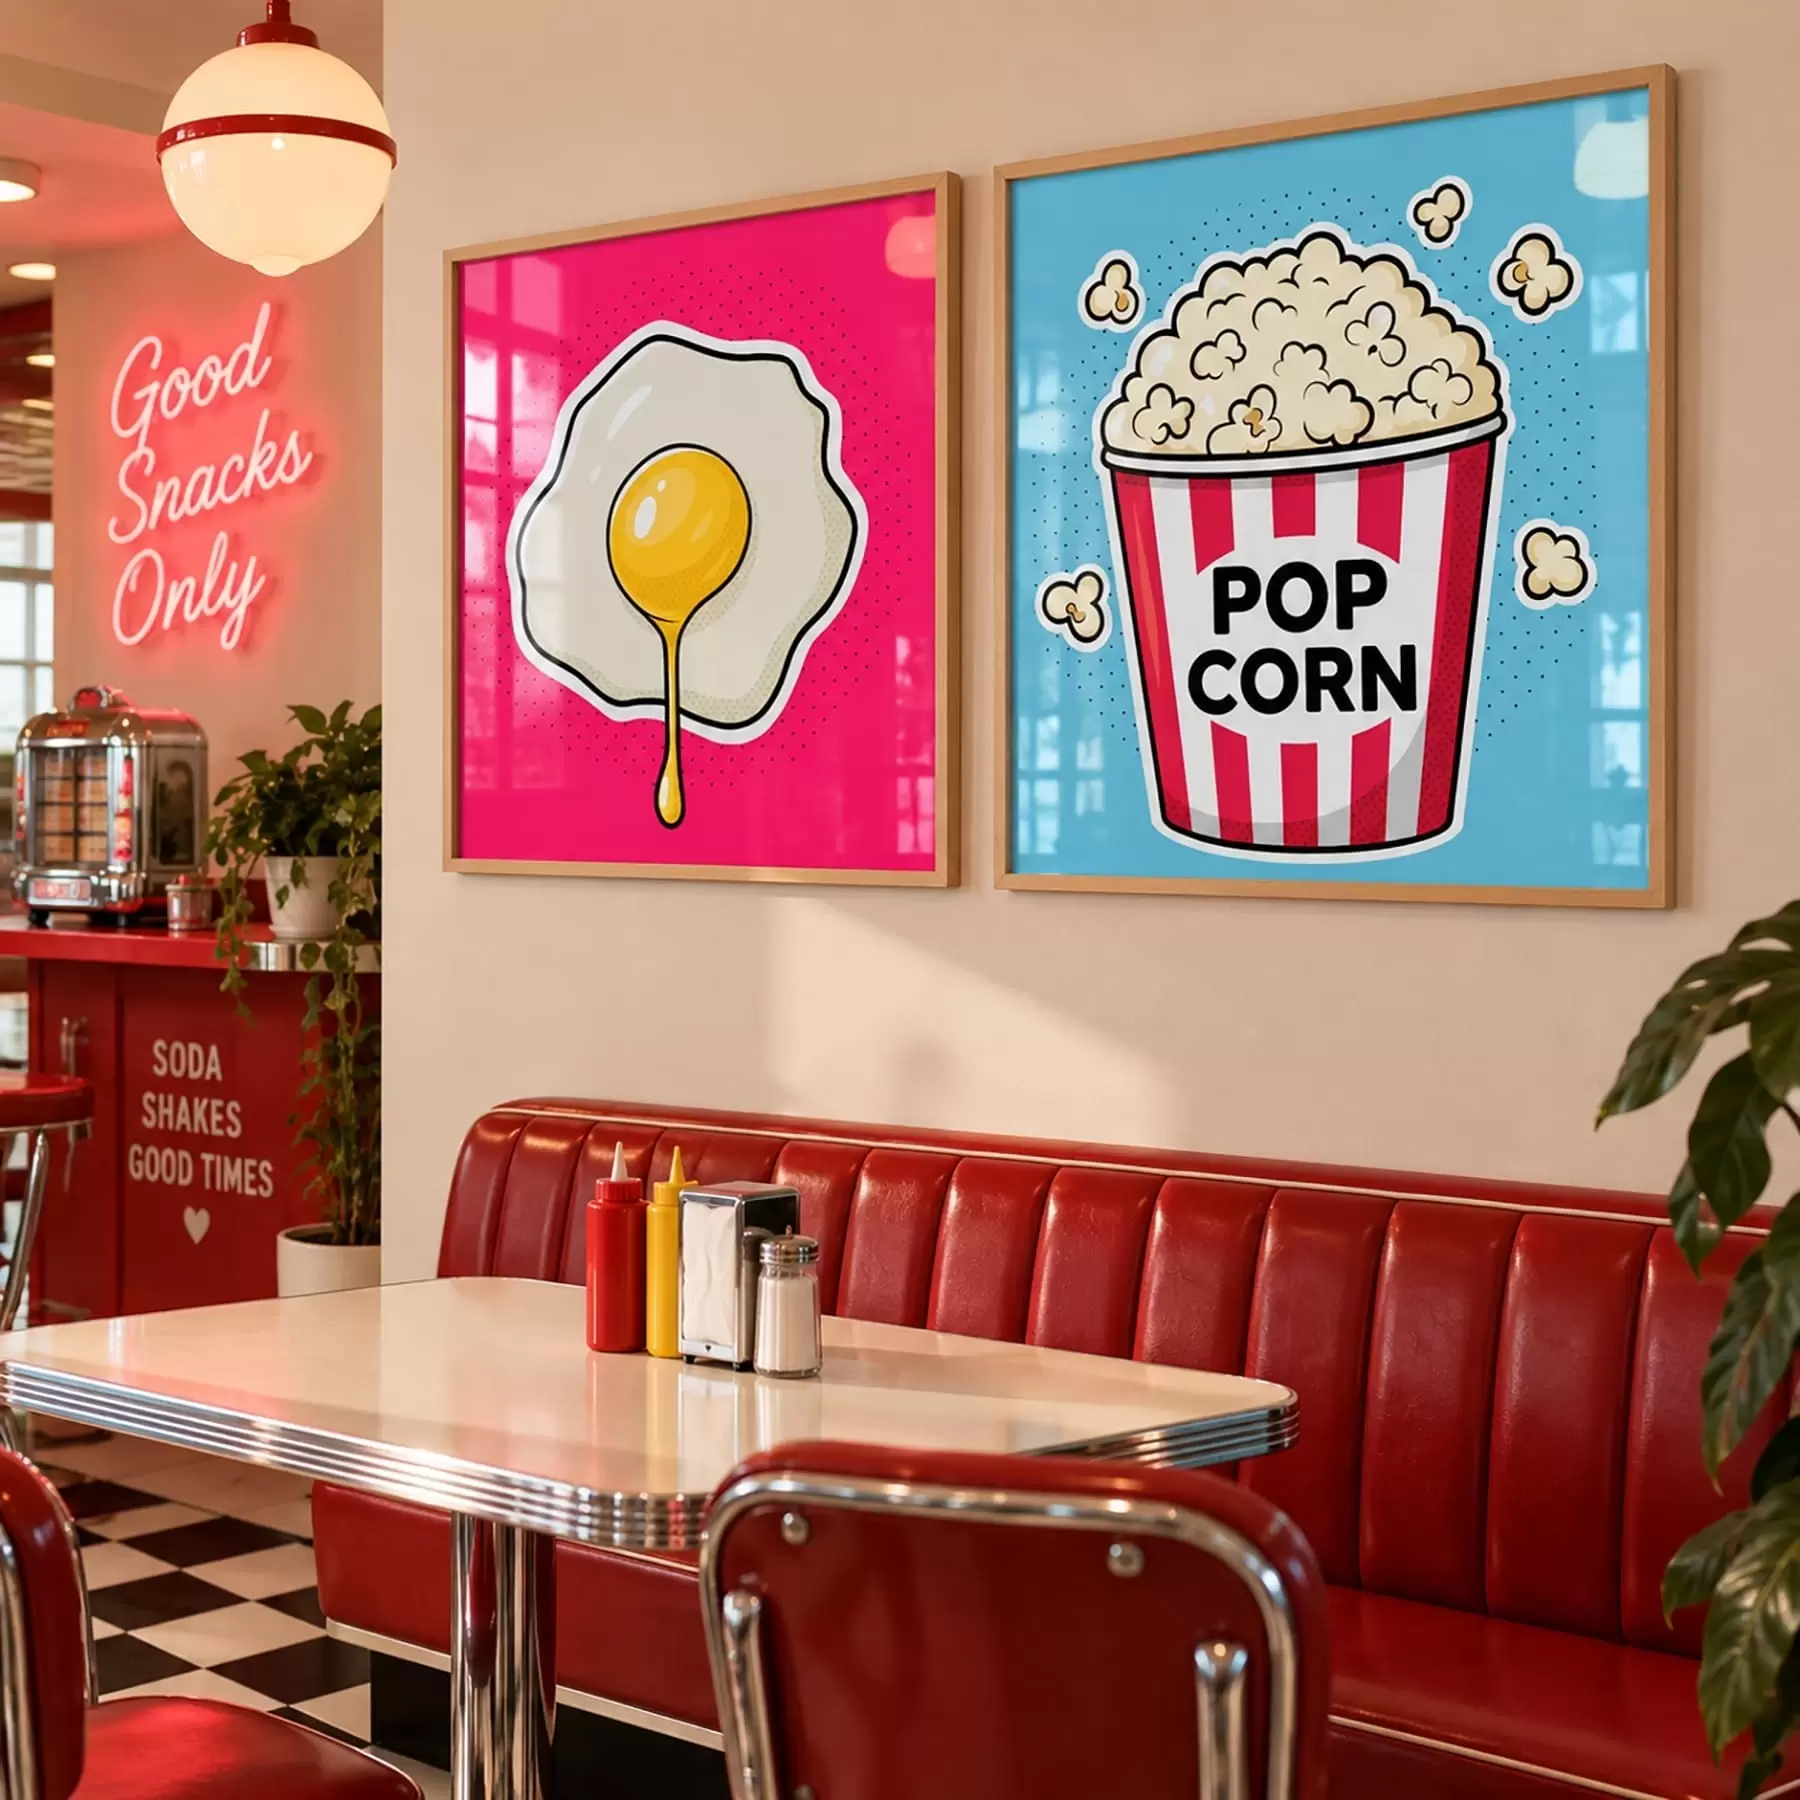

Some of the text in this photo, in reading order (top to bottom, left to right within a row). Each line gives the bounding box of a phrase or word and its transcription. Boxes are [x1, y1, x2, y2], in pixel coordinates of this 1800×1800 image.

[110, 302, 272, 452] Good
[107, 409, 312, 544] Snacks
[112, 531, 265, 650] Only
[1213, 558, 1388, 635] POP
[1187, 644, 1417, 715] CORN
[152, 1038, 223, 1080] SODA
[141, 1091, 242, 1138] SHAKES
[128, 1144, 273, 1197] GOOD TIMES
